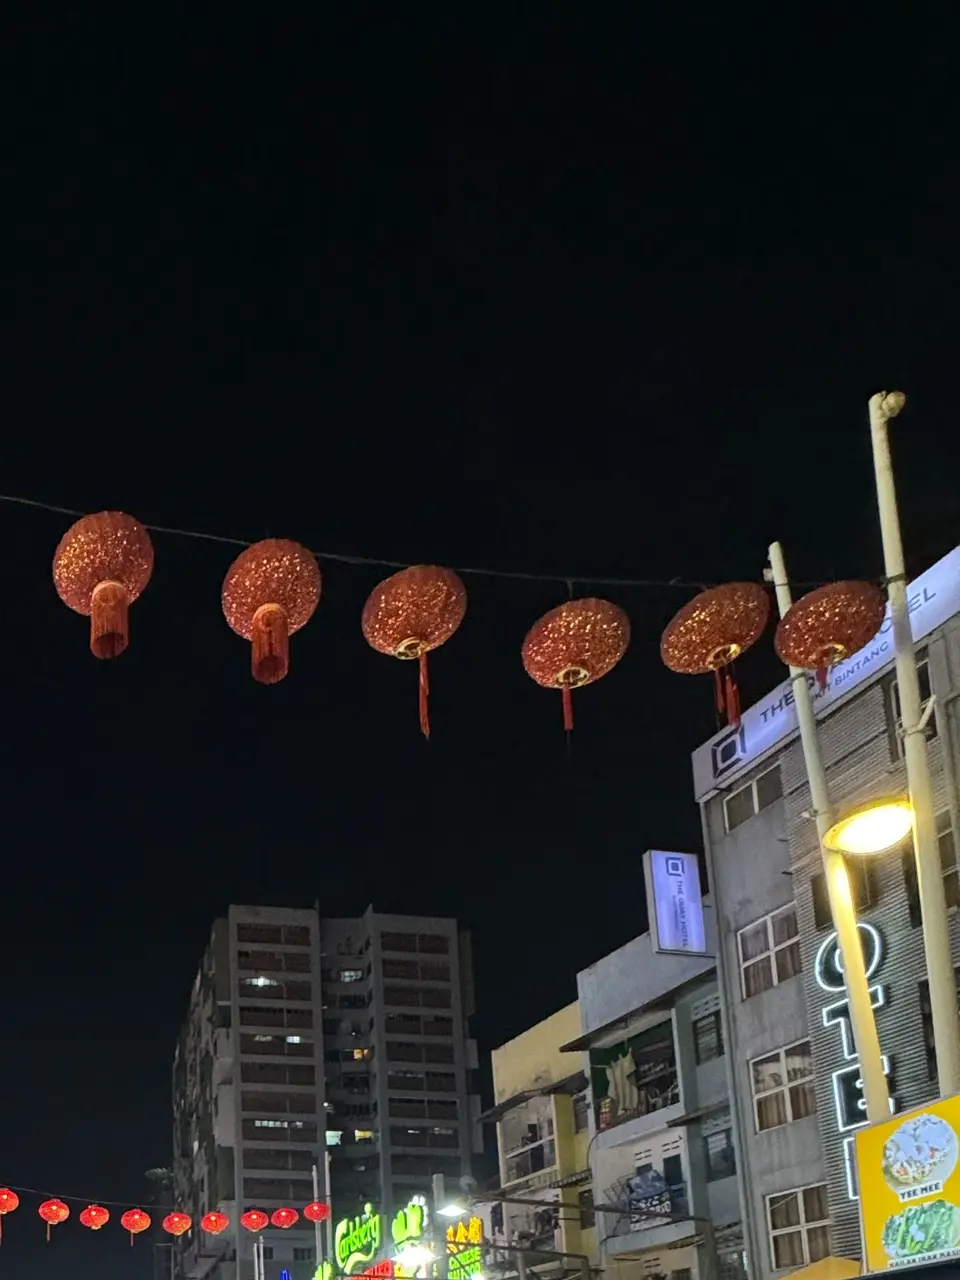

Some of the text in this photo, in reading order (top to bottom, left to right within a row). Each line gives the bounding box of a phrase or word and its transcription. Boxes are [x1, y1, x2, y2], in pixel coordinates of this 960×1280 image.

[834, 641, 890, 685] BINTANG
[900, 1181, 941, 1200] YEE MEE
[335, 1212, 381, 1269] Carlsberg
